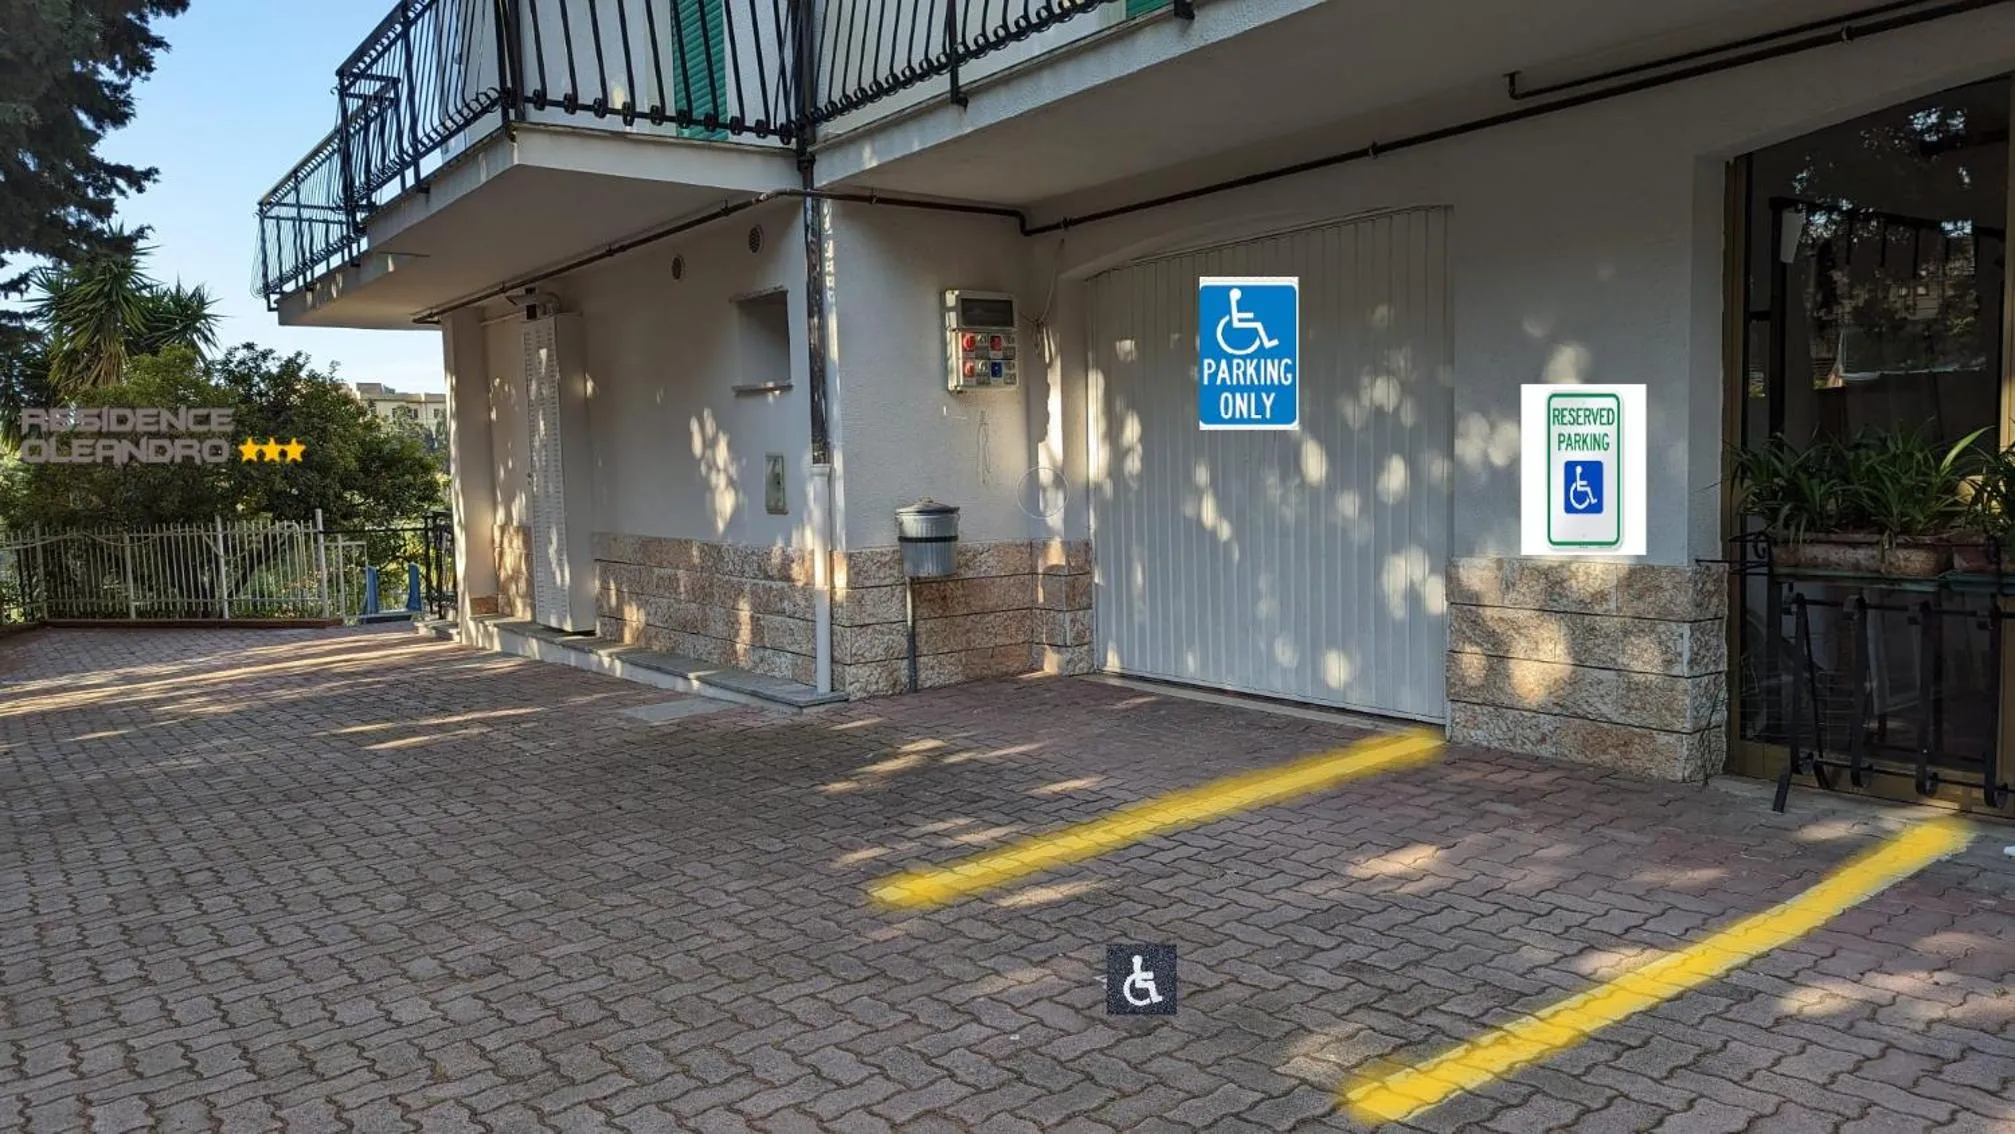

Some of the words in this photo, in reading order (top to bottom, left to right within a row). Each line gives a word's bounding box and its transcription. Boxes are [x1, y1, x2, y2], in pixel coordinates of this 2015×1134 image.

[1202, 358, 1293, 386] PARKING
[1219, 391, 1276, 420] ONLY
[1552, 407, 1615, 426] RESERVED
[1557, 432, 1610, 452] PARKING
